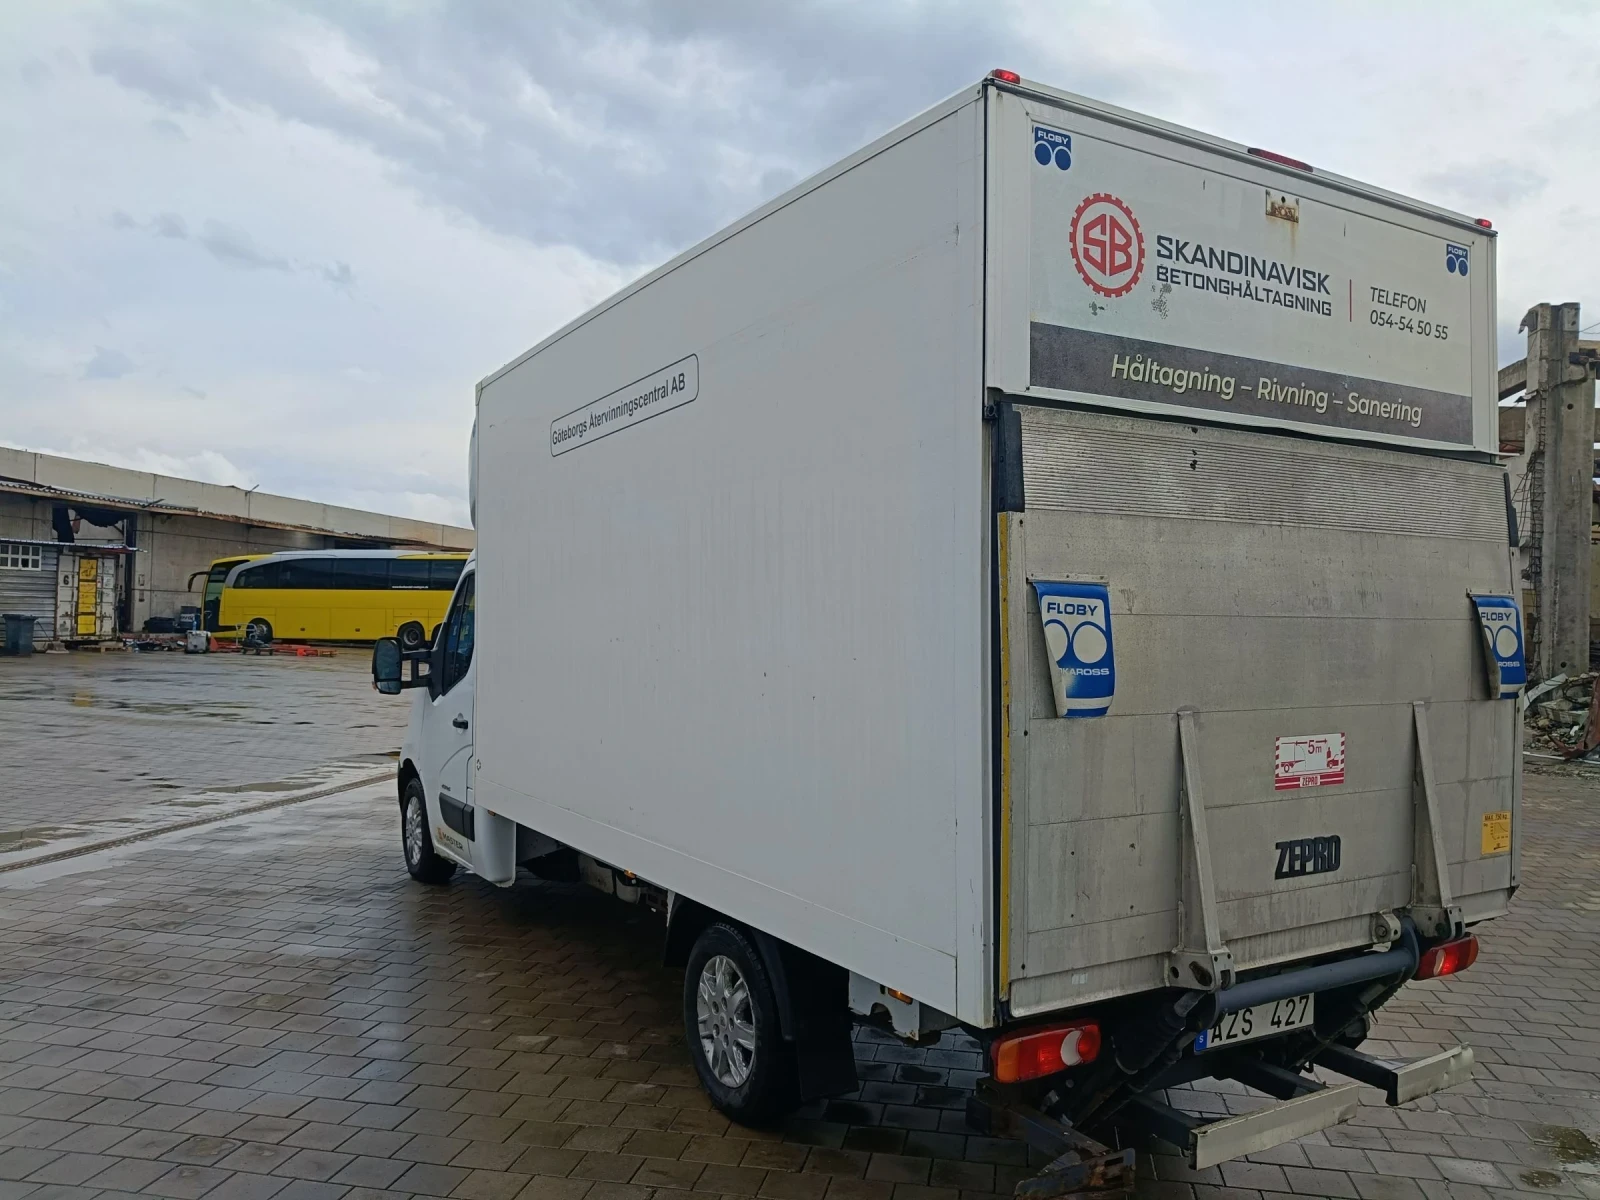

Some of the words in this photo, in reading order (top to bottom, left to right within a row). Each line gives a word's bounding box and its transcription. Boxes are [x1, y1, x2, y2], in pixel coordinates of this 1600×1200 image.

[1037, 130, 1070, 145] FLOBY
[1082, 213, 1133, 276] SB
[1447, 246, 1469, 257] FLOBY
[1156, 234, 1332, 296] SKANDINAVISK
[1156, 265, 1333, 317] BETONGHÅLTAGNING
[1370, 286, 1427, 313] TELEFON
[1370, 308, 1414, 333] 054-54
[1416, 319, 1432, 336] 50
[1434, 324, 1449, 340] 55
[1111, 353, 1237, 401] Håltagning
[1257, 376, 1329, 413] Rivning
[1346, 391, 1423, 428] Sanering
[552, 420, 588, 445] Göteborgs
[589, 379, 669, 430] Återvinningscentral
[670, 372, 686, 395] AB
[1047, 602, 1098, 616] FLOBY
[1480, 611, 1513, 622] FLOBY
[1302, 776, 1318, 786] ZEPRO
[442, 833, 463, 851] MASTER
[1275, 835, 1342, 880] ZEPRO
[1198, 1035, 1204, 1043] S
[1211, 1008, 1253, 1043] AZS
[1270, 995, 1310, 1029] 427
